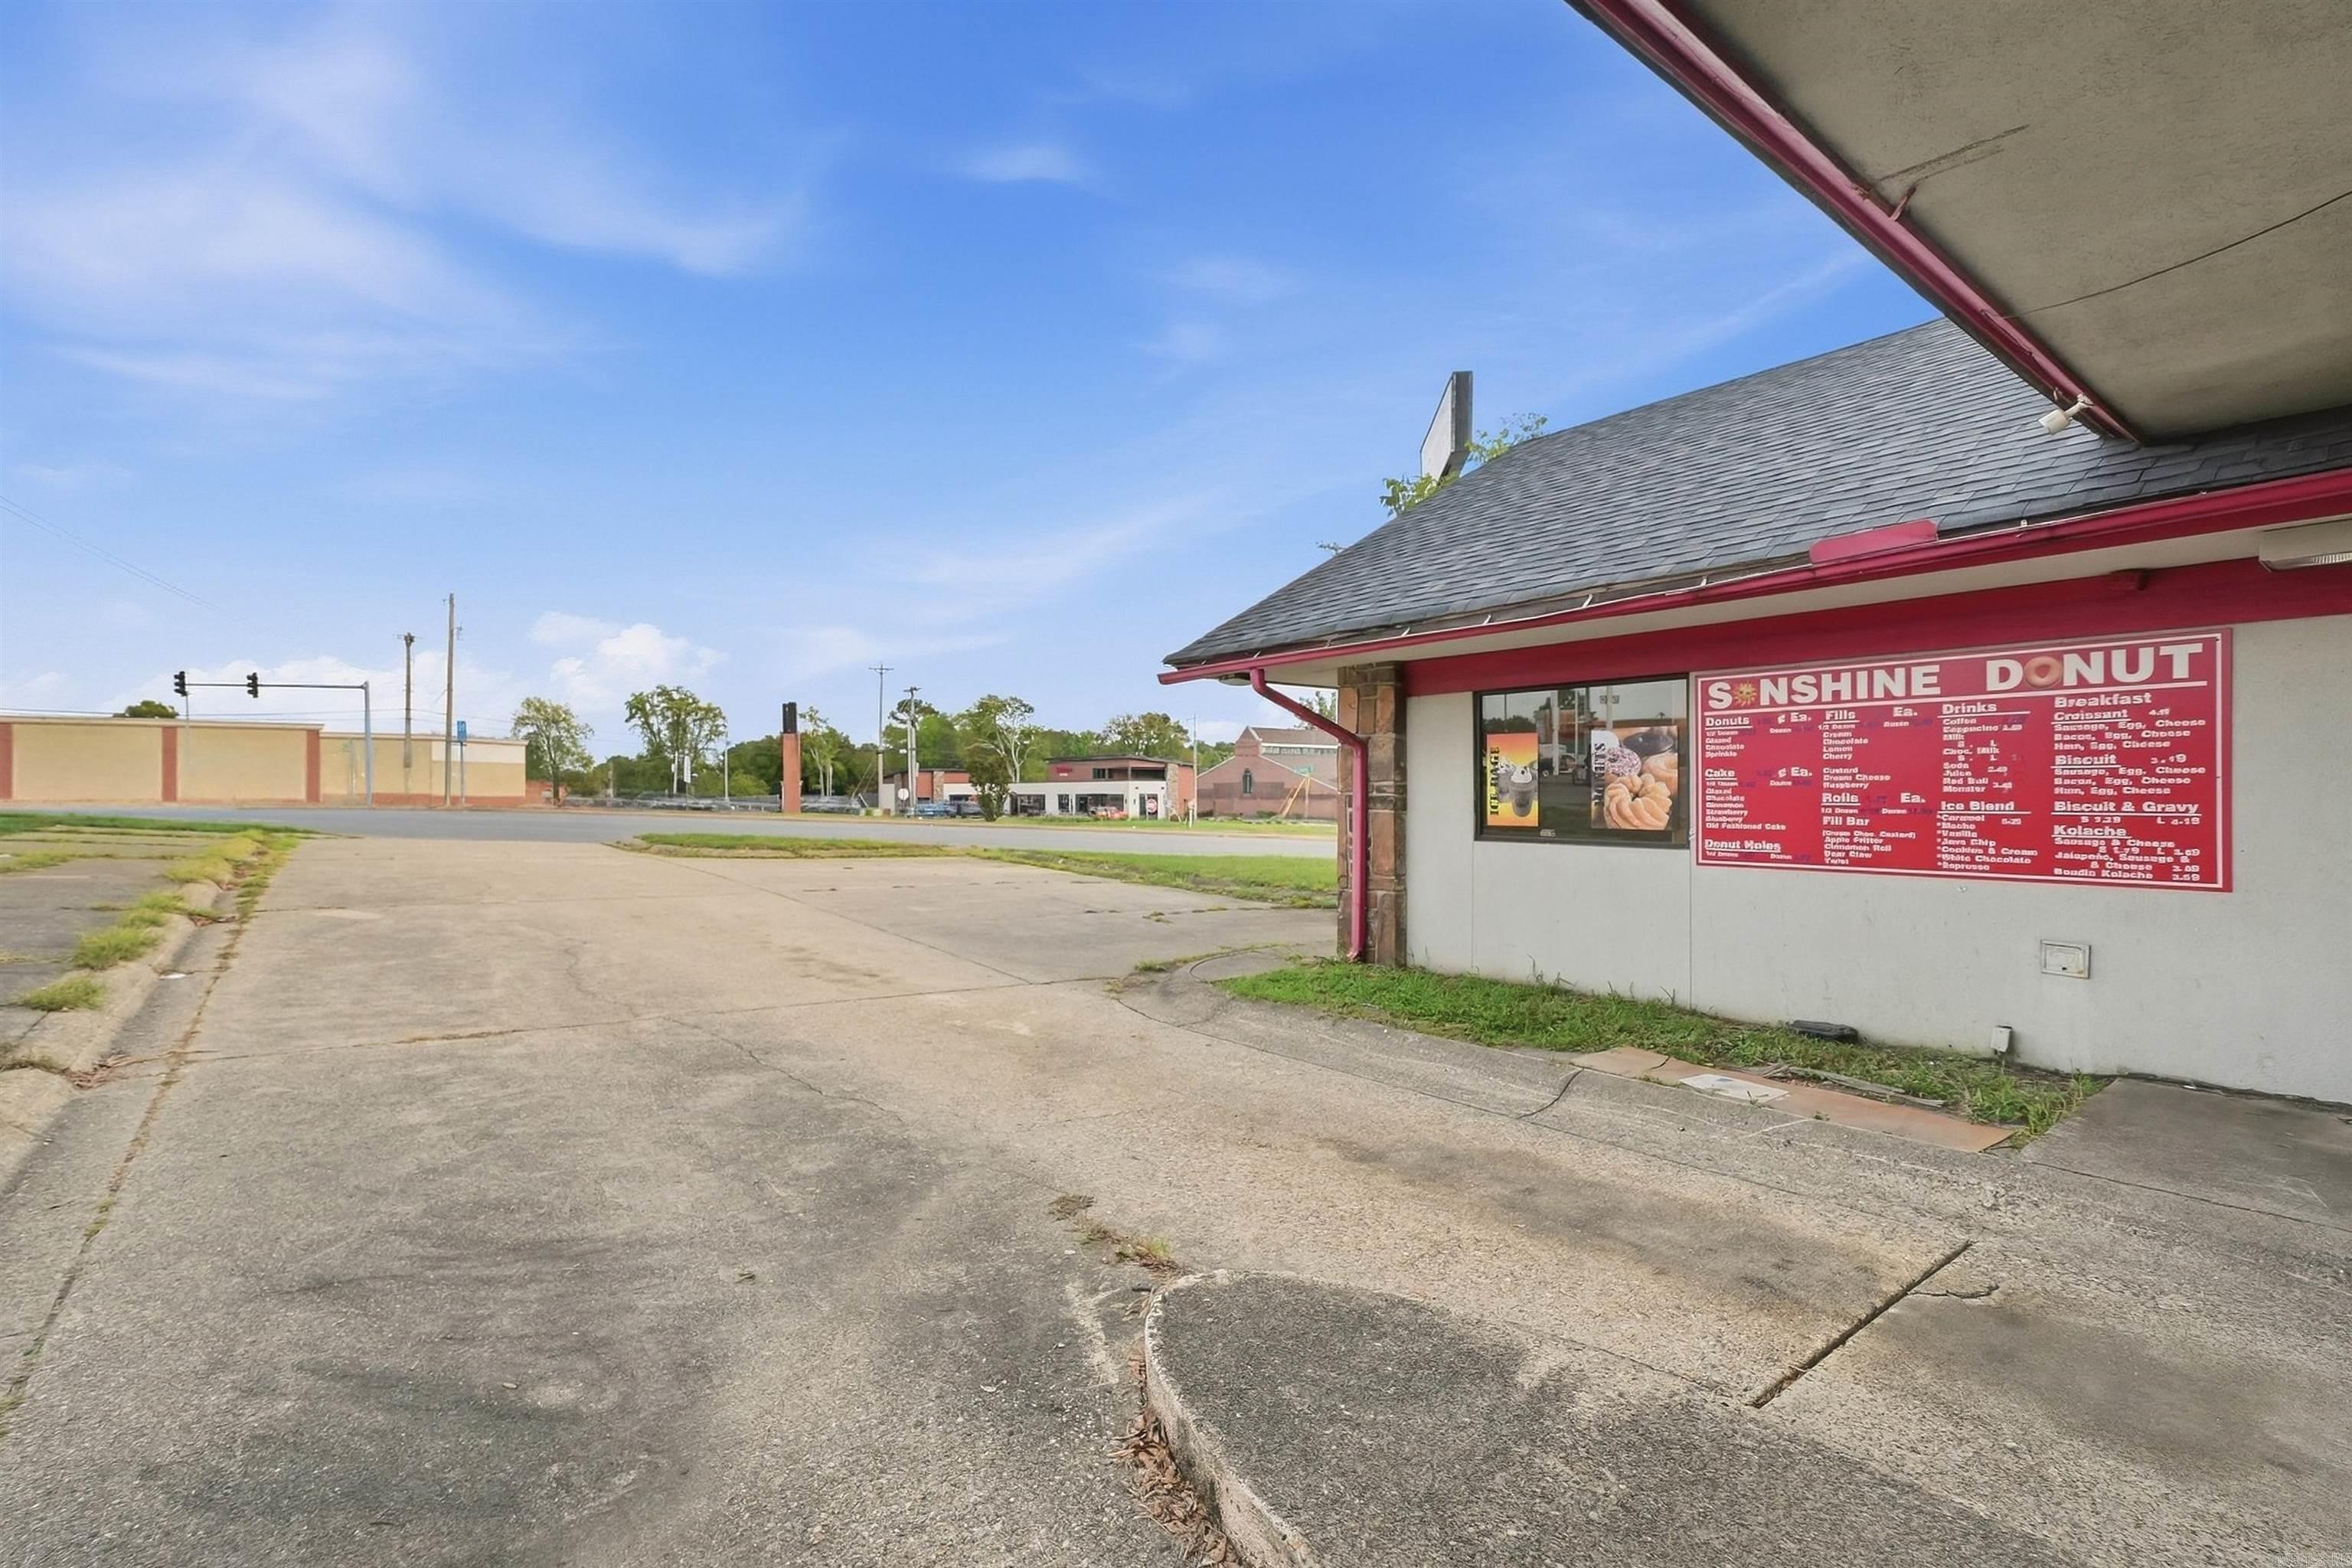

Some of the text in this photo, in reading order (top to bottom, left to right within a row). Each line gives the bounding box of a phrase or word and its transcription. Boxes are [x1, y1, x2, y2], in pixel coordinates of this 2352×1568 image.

[1986, 643, 2203, 691] DONUT
[2054, 692, 2152, 708] Breakfast
[1942, 702, 1997, 714] Drinks
[1825, 707, 1917, 720] Fills Ea.
[2054, 710, 2128, 720] Croissant
[1706, 717, 1749, 727] Donuts
[1791, 712, 1811, 722] Ea.
[2155, 719, 2206, 727] Cheese
[2141, 730, 2190, 738] Cheese
[2055, 754, 2117, 766] Biscuit
[1705, 769, 1735, 777] Cake
[1791, 767, 1812, 776] Ea.
[2141, 776, 2190, 785] Cheese
[2122, 786, 2171, 795] Cheese
[1822, 792, 1858, 802] Rolls
[1900, 792, 1926, 803] Ea.
[1490, 793, 1499, 815] ICE
[1941, 801, 2014, 810] Ice Blend
[2054, 801, 2199, 814] Biscuit & Gravy
[1823, 816, 1870, 826] Fill Bar
[2054, 825, 2127, 836] Kolache
[1705, 839, 1781, 851] Donut Holes
[1971, 838, 1996, 847] Chip
[1975, 855, 2031, 864] Chocolate
[2101, 870, 2153, 879] Kolache
